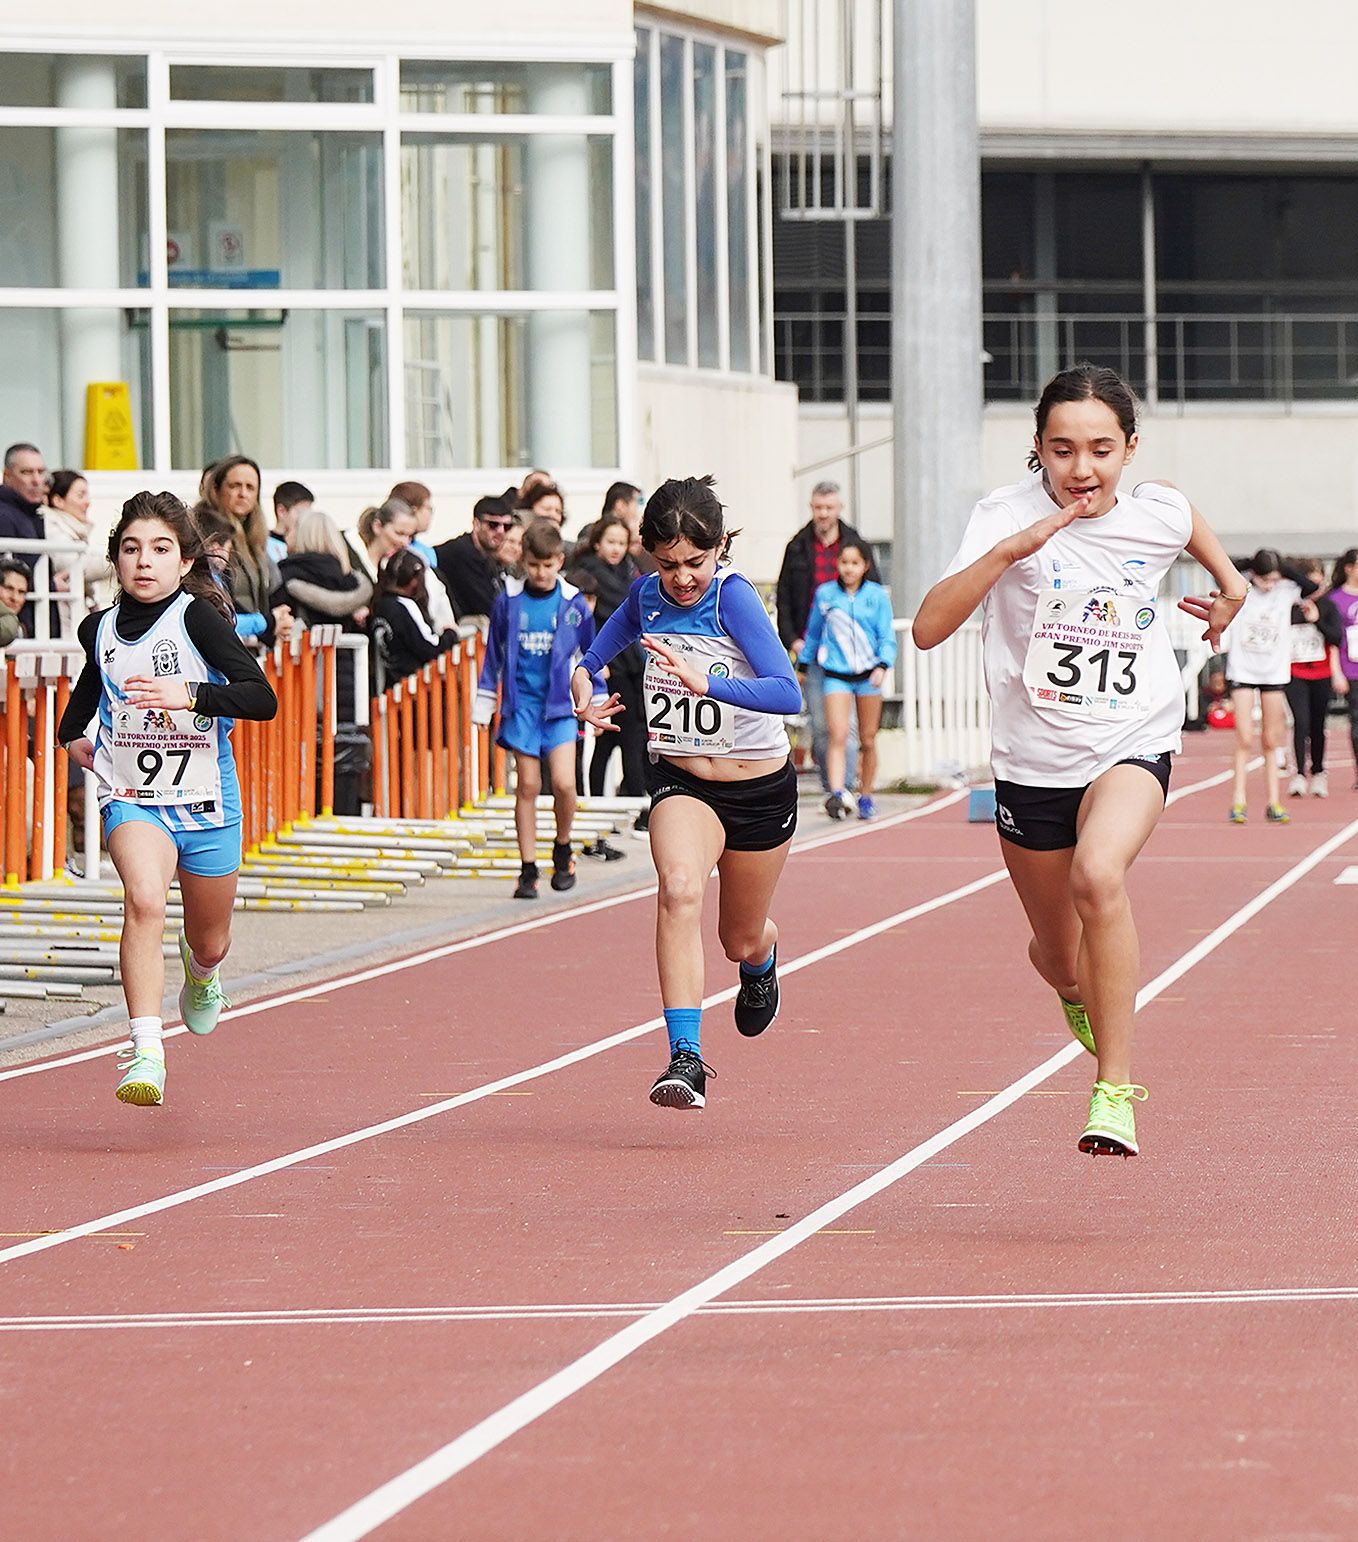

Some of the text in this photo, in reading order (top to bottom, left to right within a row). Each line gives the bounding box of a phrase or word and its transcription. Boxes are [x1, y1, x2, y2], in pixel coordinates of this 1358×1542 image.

[1057, 623, 1096, 635] TORNEO
[1112, 631, 1130, 639] REIS
[1034, 632, 1144, 651] GRAN PREMIO JIM SPORTS
[1047, 642, 1137, 695] 313
[653, 676, 677, 686] TORNEO
[657, 686, 681, 696] PREMIO
[649, 692, 721, 735] 210
[137, 749, 191, 786] 97
